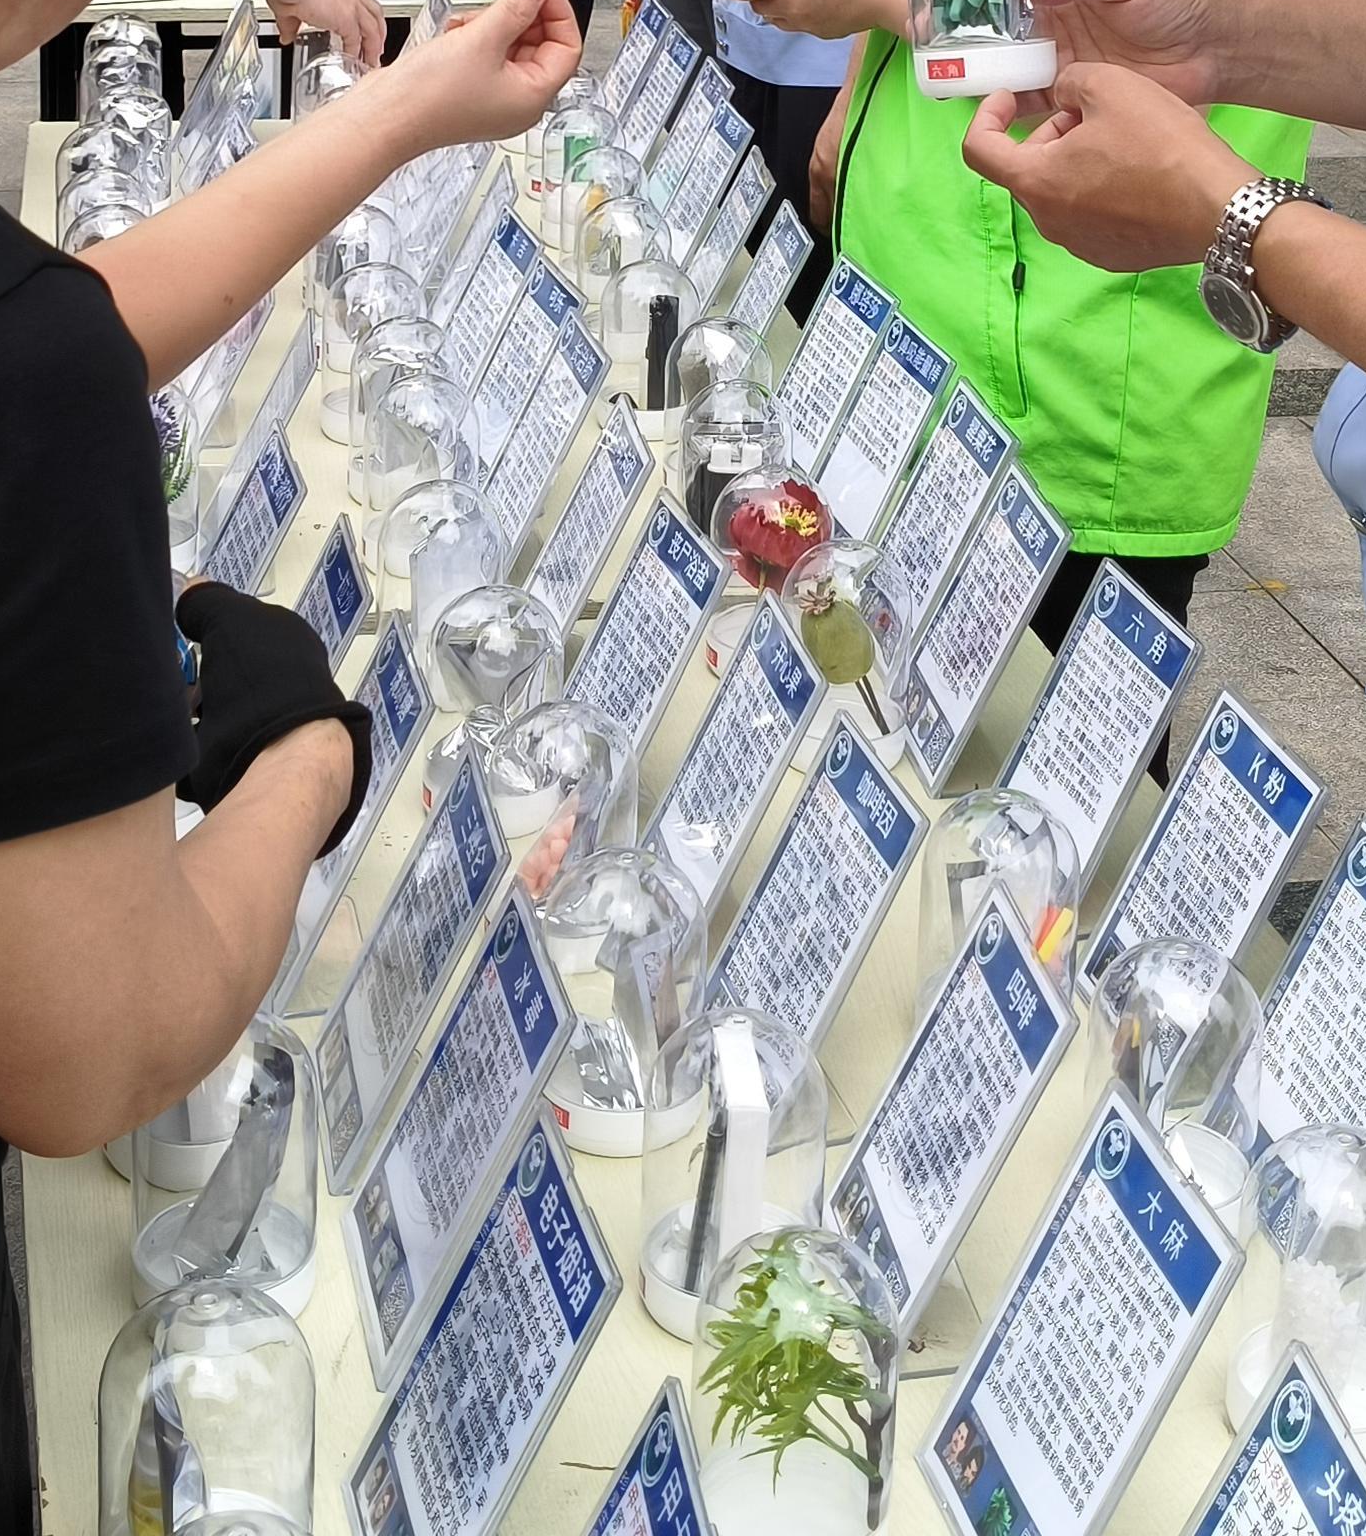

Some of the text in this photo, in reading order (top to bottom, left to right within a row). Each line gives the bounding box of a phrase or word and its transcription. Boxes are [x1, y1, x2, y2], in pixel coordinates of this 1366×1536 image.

[671, 531, 711, 593] 丧尸浴盐
[1124, 611, 1169, 665] 六角
[768, 639, 804, 700] 开心果
[856, 768, 900, 840] 咖啡因
[1247, 751, 1287, 806] K粉
[1004, 967, 1038, 1032] 吗啡
[1137, 1189, 1190, 1262] 大麻
